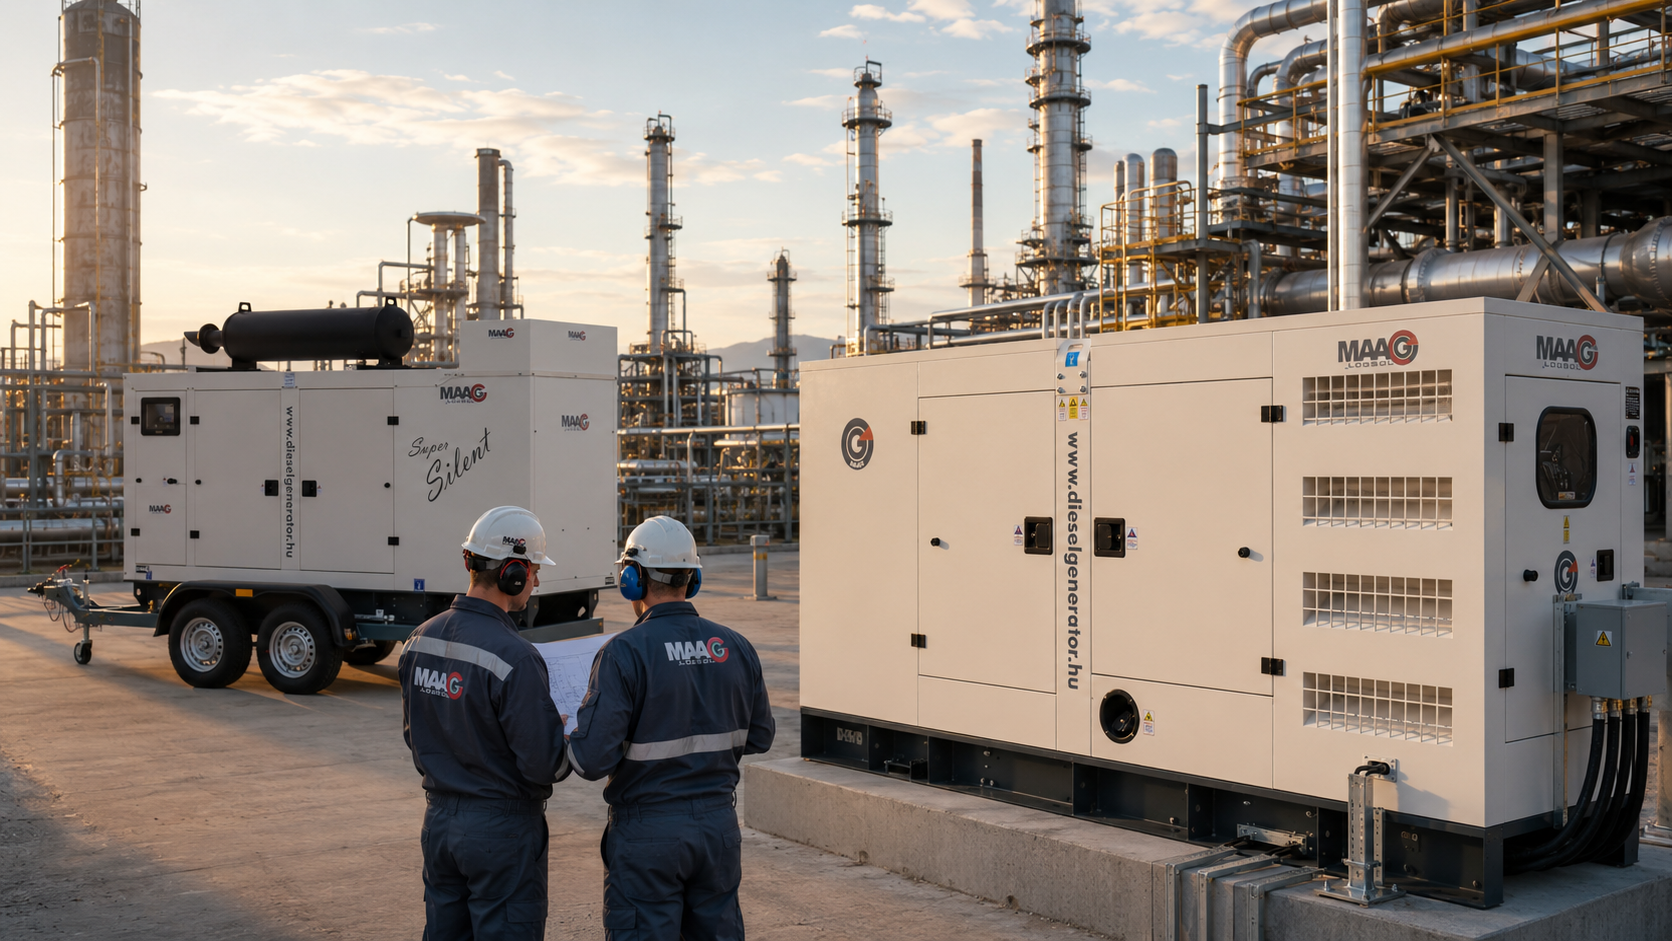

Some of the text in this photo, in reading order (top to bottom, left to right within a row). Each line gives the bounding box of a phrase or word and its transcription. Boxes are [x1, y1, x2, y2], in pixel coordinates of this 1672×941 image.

[488, 328, 514, 339] MAAG
[568, 331, 586, 341] MAAG
[1338, 330, 1419, 366] MAAG
[1536, 334, 1599, 370] MAAG
[440, 383, 487, 403] MAAG
[561, 413, 590, 431] MAAG
[408, 436, 449, 459] Super
[426, 427, 491, 502] Silent
[149, 504, 171, 514] MAAG
[1064, 431, 1083, 690] www.dieselgenerator.hu
[664, 637, 729, 663] MAAG
[414, 666, 463, 700] MAAG
